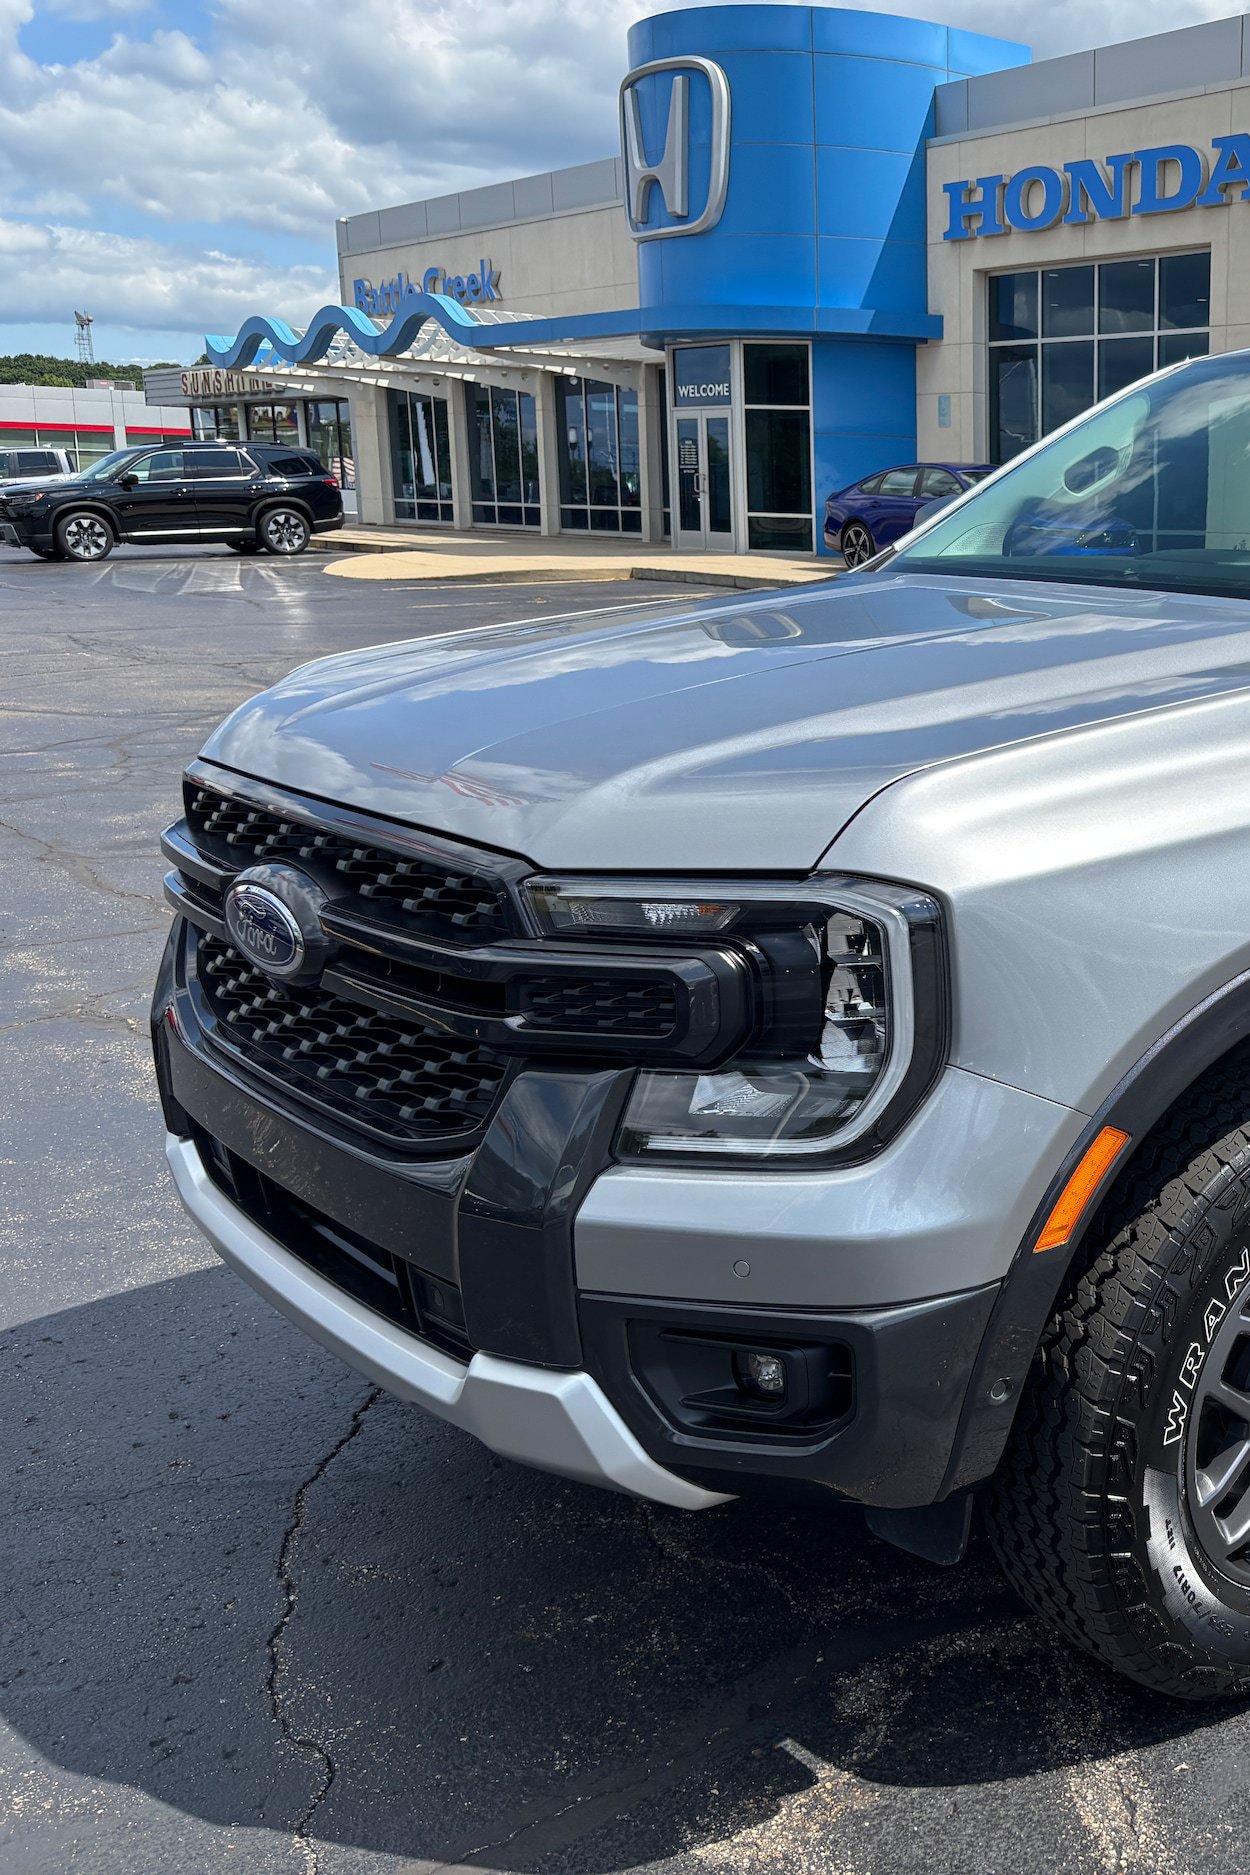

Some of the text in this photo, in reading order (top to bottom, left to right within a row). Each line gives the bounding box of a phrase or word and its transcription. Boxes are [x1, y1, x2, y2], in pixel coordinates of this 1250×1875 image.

[424, 258, 498, 303] Creek
[678, 383, 730, 398] WELCOME
[237, 901, 277, 956] Ford
